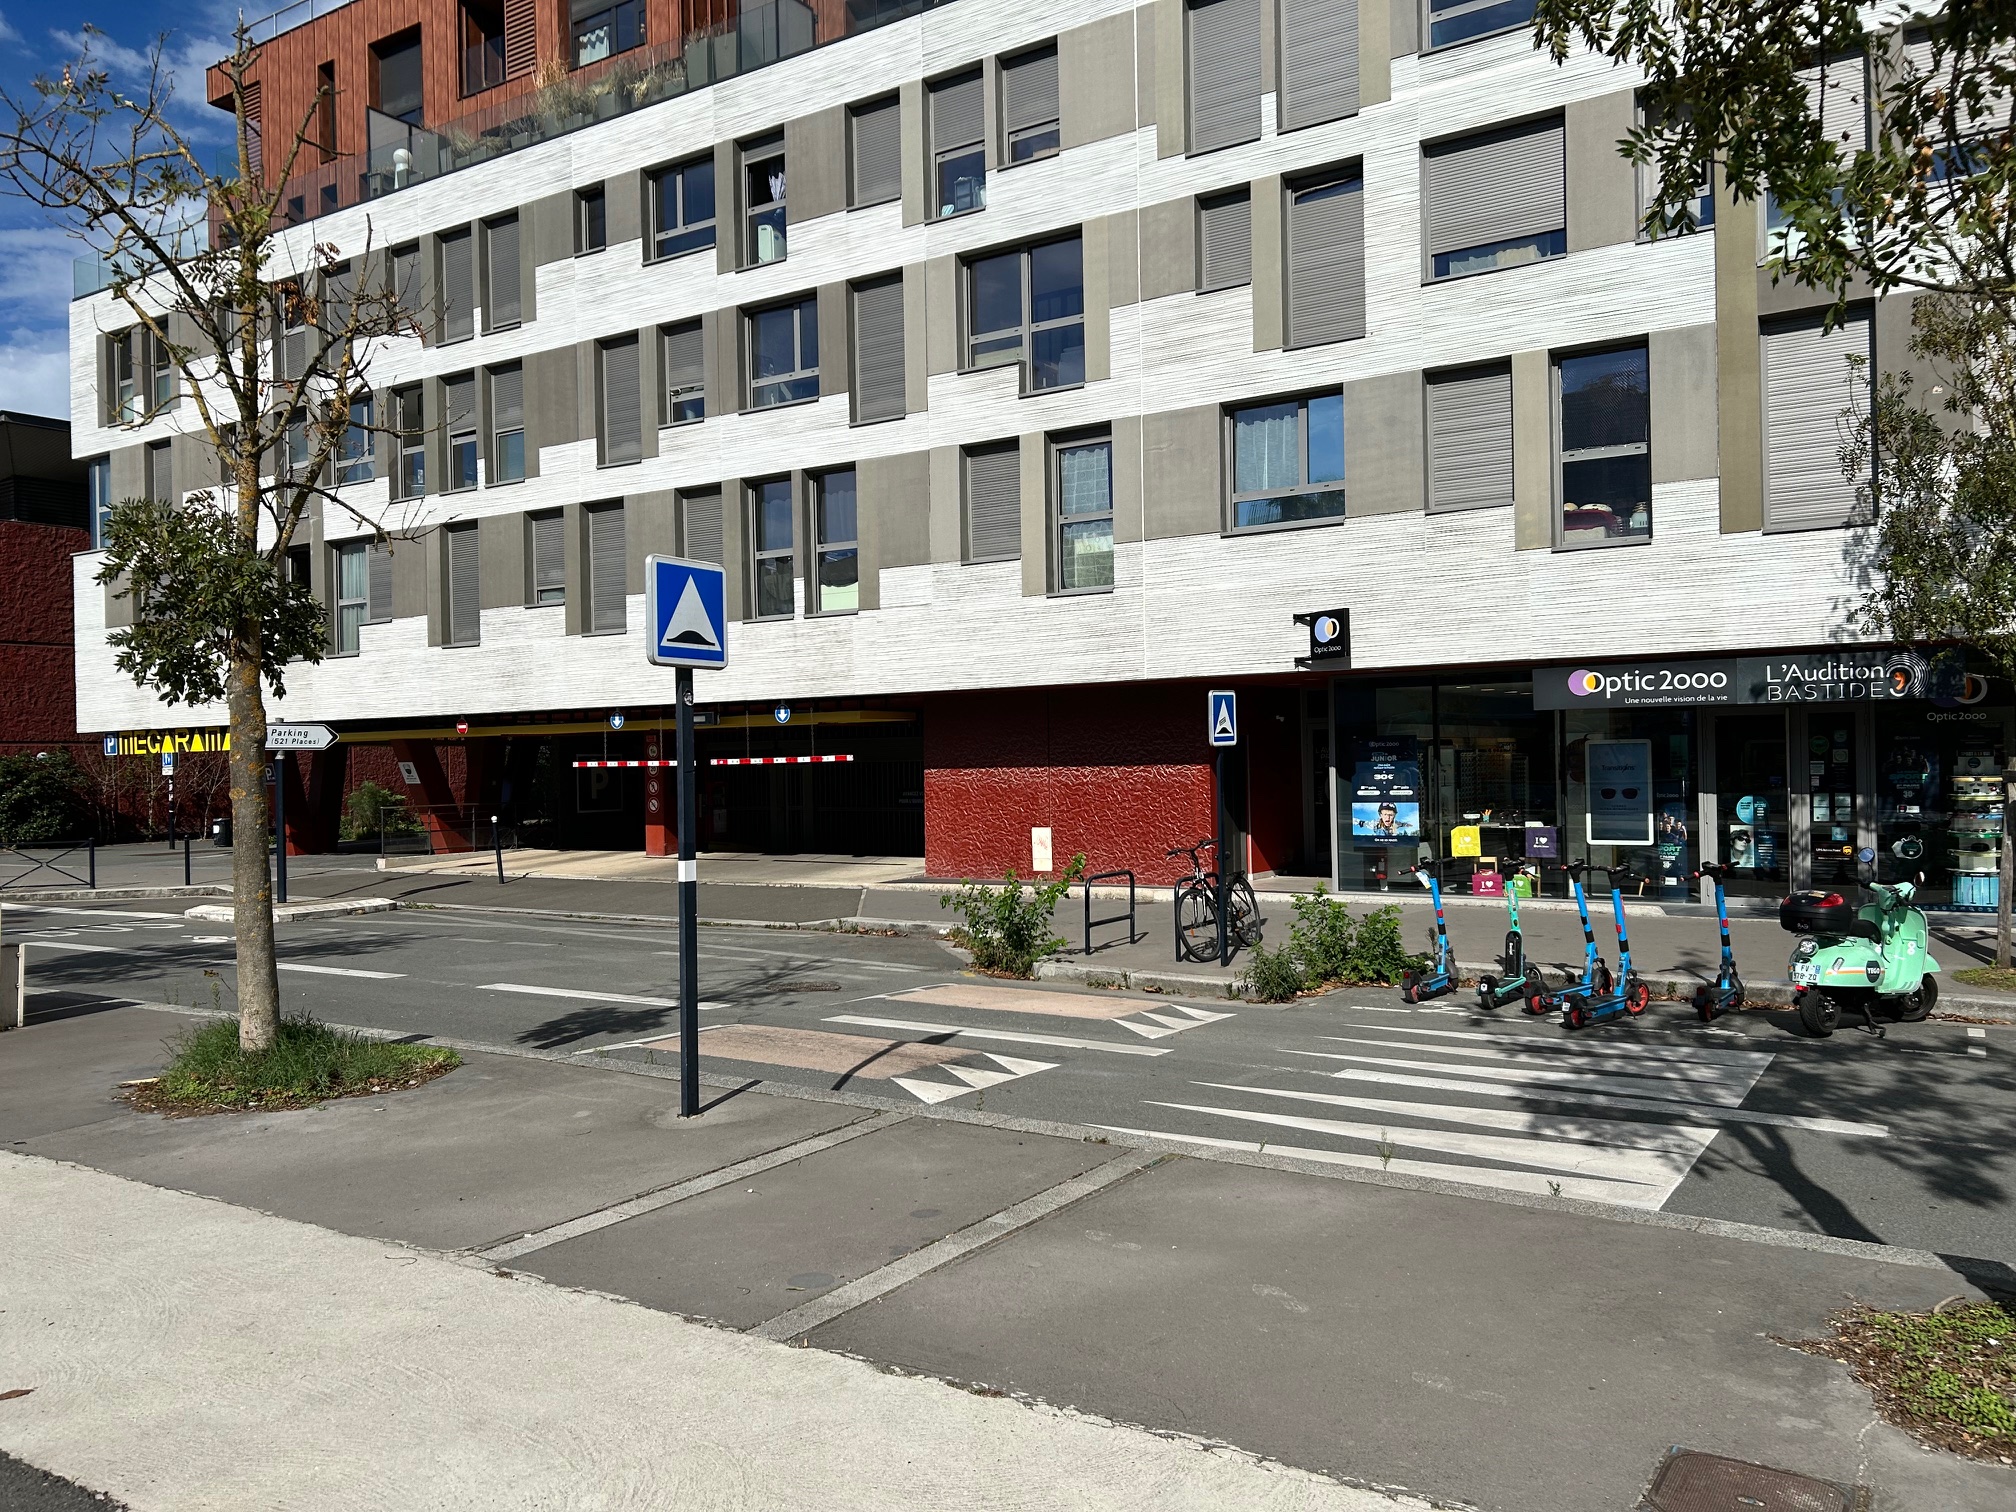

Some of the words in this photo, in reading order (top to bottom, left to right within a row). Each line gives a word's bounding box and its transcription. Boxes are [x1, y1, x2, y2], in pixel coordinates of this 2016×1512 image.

[1313, 645, 1328, 655] Optic
[1766, 661, 1884, 683] L'Audition
[1582, 670, 1655, 698] Optic
[1659, 670, 1728, 690] 2000
[1767, 682, 1884, 700] BASTIDE
[1640, 695, 1672, 704] nouvelle
[1696, 694, 1706, 702] de
[1926, 712, 1958, 723] Optic
[1959, 712, 1987, 721] 2000
[271, 728, 309, 738] Parking
[107, 735, 115, 752] P
[271, 737, 288, 745] (521
[291, 737, 320, 745] Places)
